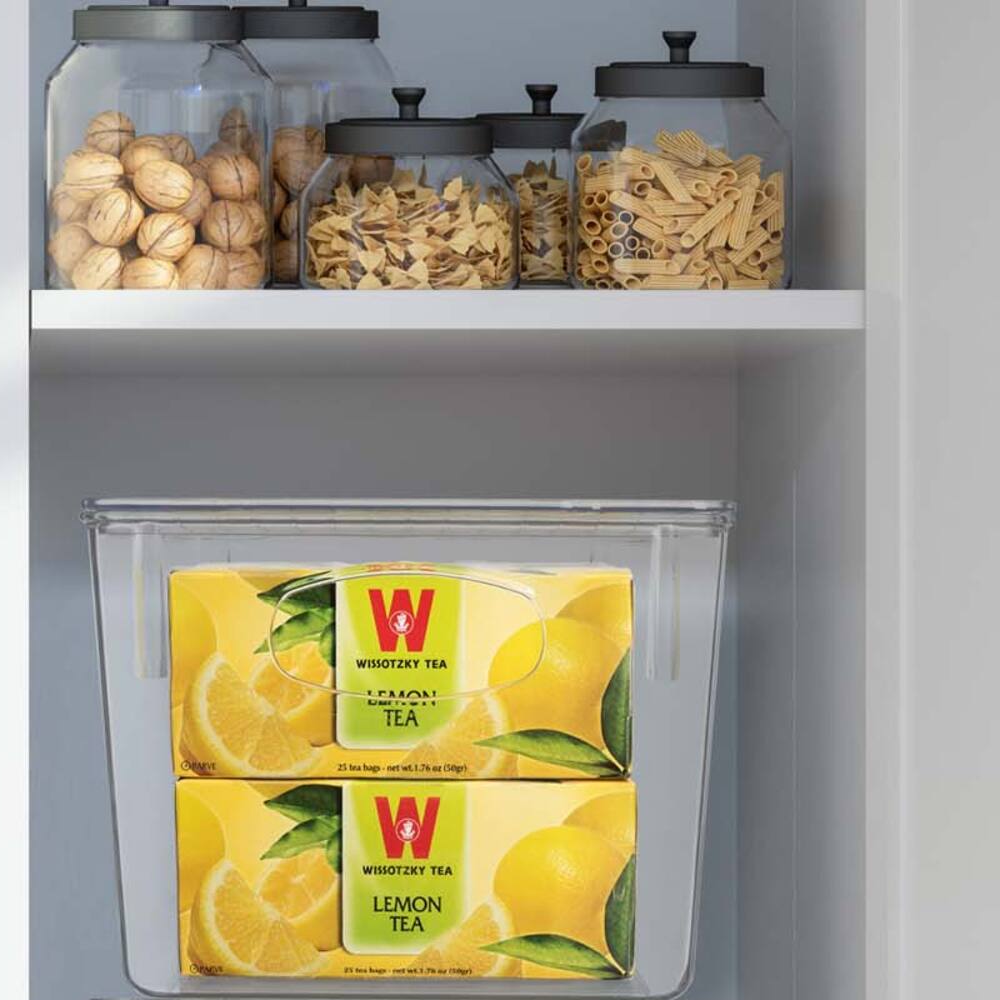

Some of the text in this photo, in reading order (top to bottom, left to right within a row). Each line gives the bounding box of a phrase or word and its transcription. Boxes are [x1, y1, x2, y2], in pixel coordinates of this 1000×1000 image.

[356, 659, 448, 669] WISSOTZKY TEA
[367, 690, 436, 706] LEMON
[384, 709, 419, 727] TEA
[349, 764, 361, 772] tea
[363, 763, 380, 774] bags
[386, 764, 400, 772] net
[362, 866, 453, 876] WISSOTZKY TEA
[373, 896, 442, 912] LEMON
[390, 916, 424, 932] TEA
